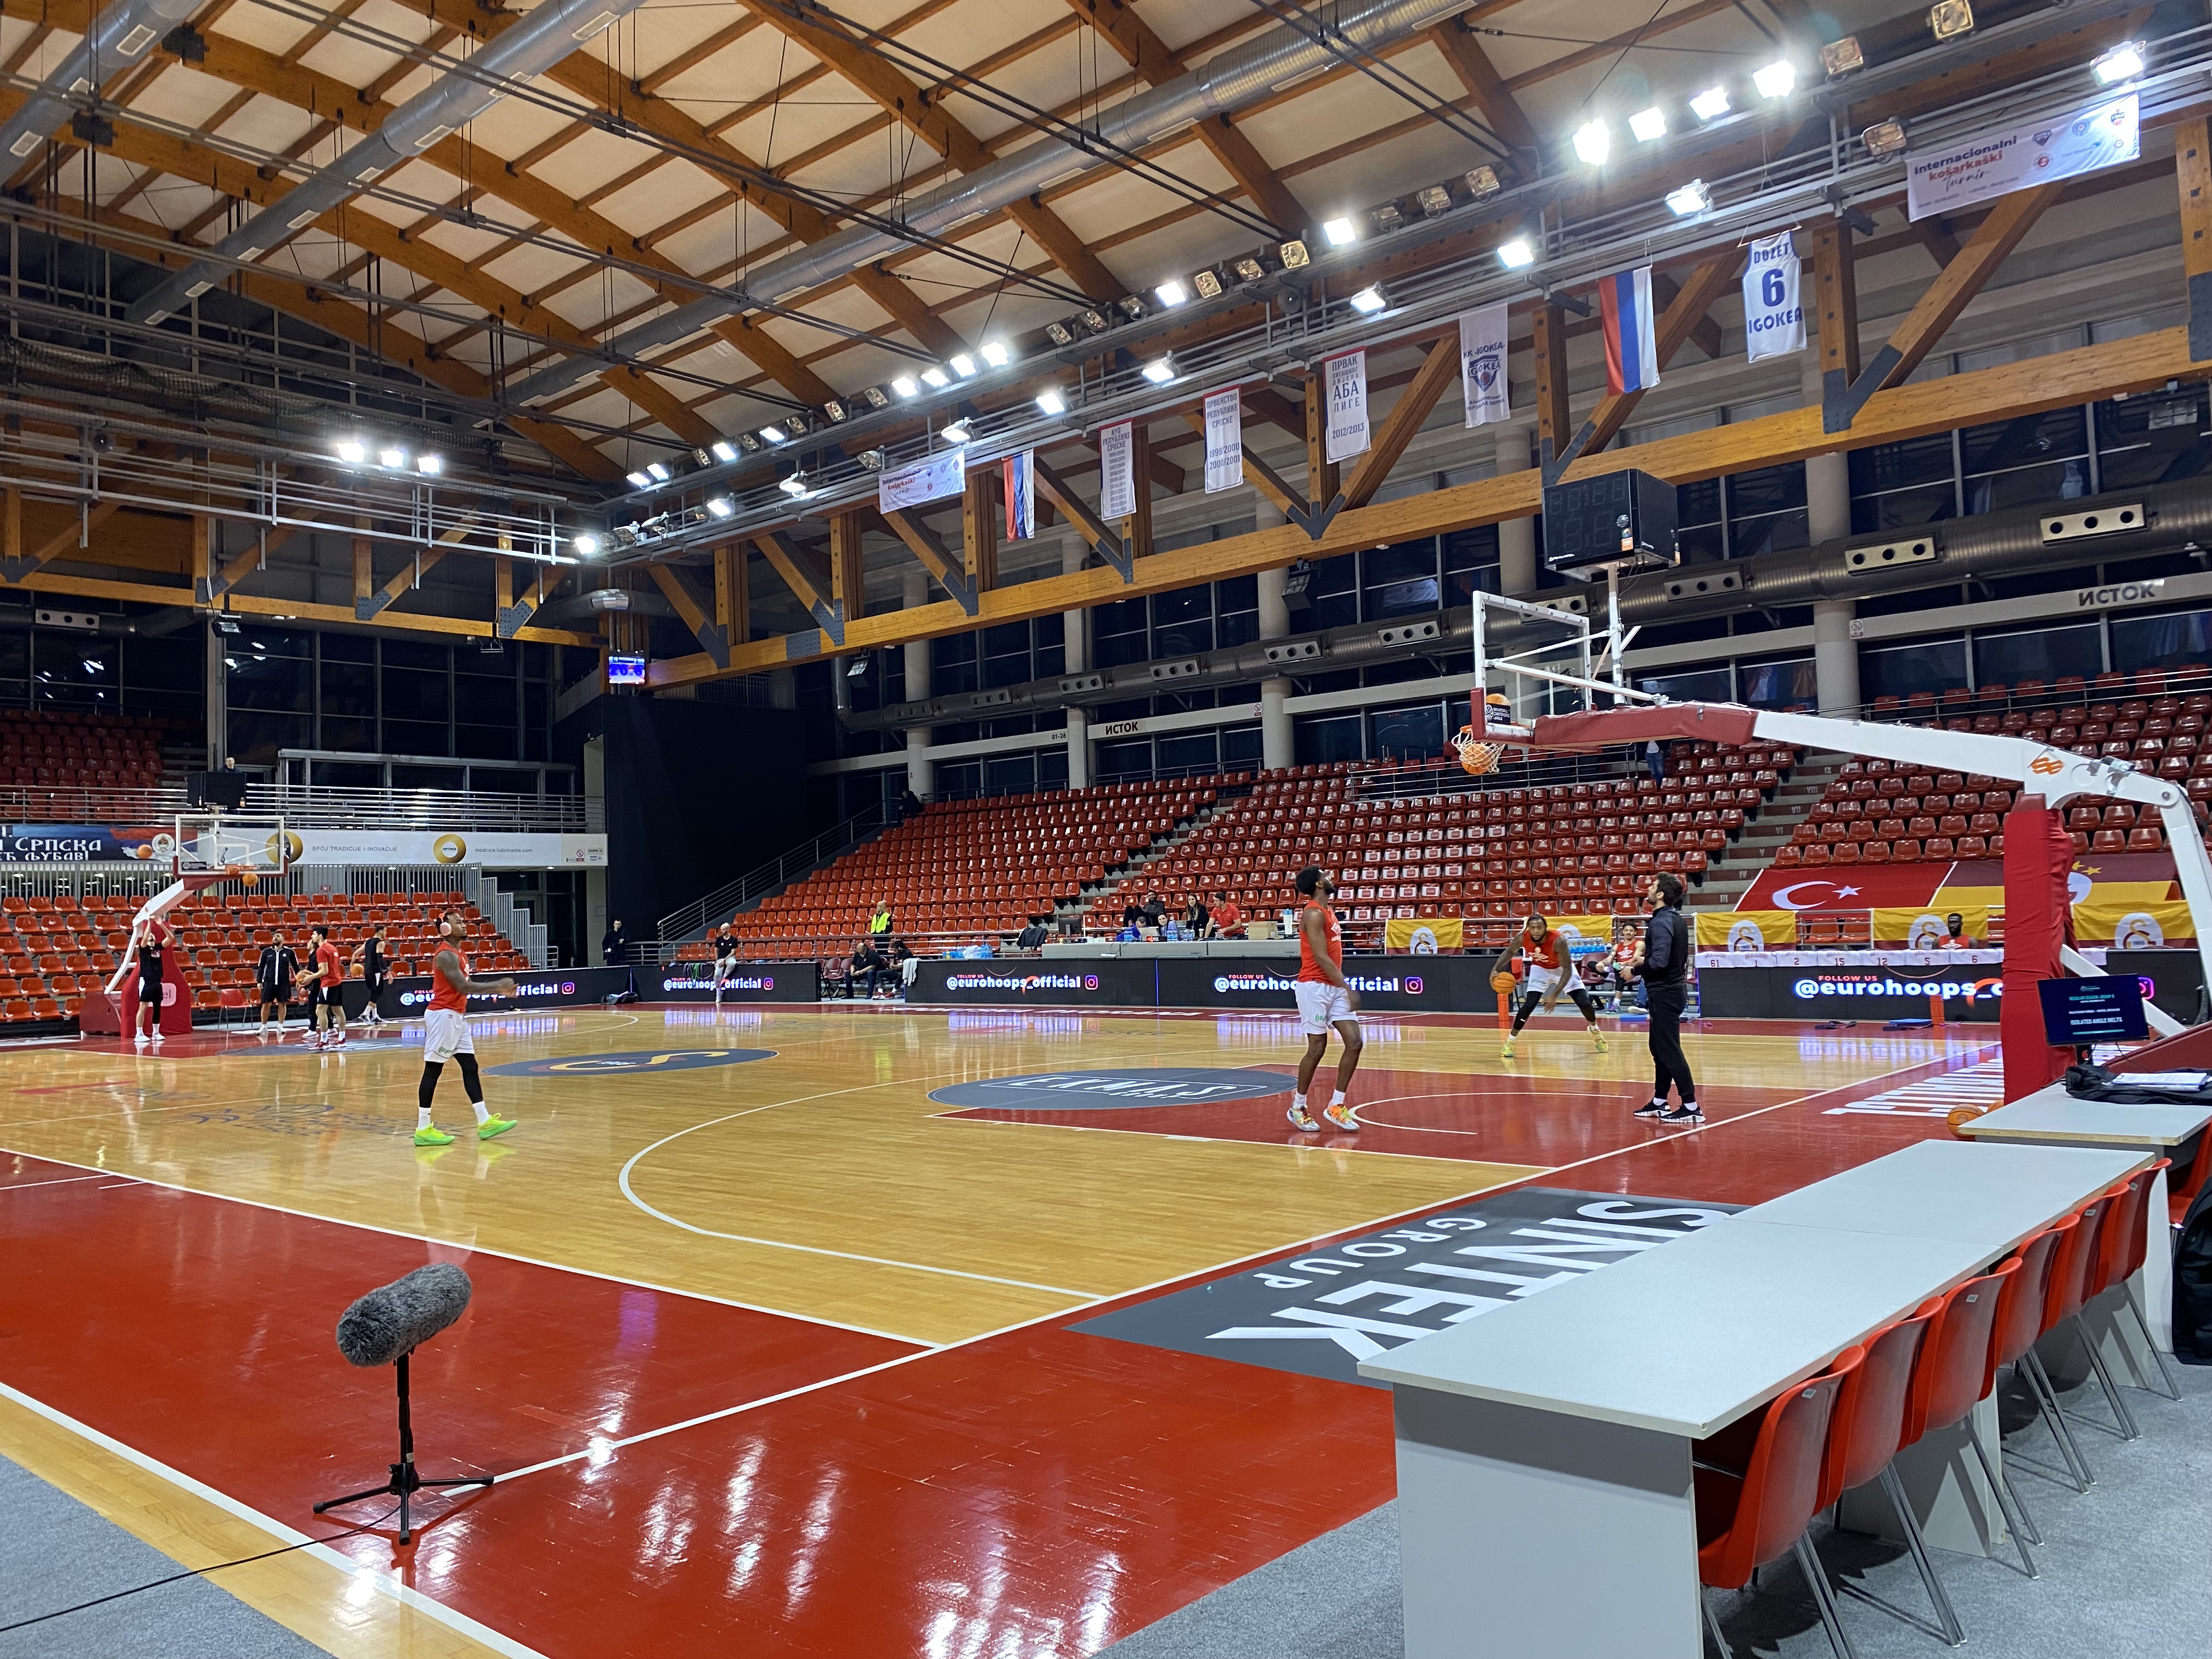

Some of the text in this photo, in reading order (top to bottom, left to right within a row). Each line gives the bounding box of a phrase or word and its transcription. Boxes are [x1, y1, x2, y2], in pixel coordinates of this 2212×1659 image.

[1915, 136, 2017, 174] Internacionalni
[1929, 150, 2002, 181] košarkaški
[1754, 242, 1789, 264] DOZET
[1762, 268, 1785, 307] 6
[1748, 306, 1803, 334] IGOKEA
[1463, 350, 1472, 358] KK
[1332, 356, 1358, 371] ПРВАК
[1468, 361, 1500, 376] IGOKEA
[1333, 380, 1359, 400] АБА
[1207, 393, 1237, 409] ПРВЕНСТВО
[1334, 397, 1360, 413] ЛИГЕ
[1207, 403, 1238, 419] РЕПУБЛИКЕ
[1111, 427, 1121, 436] КУП
[1332, 422, 1364, 439] 2012/2013
[1210, 442, 1239, 458] 1999/2000
[1210, 454, 1240, 470] 2000/2001
[2079, 583, 2155, 606] ИСТОК
[1105, 721, 1138, 735] ИСТОК
[1835, 957, 1844, 966] 15
[1877, 957, 1888, 966] 12
[947, 975, 1081, 990] @eurohoops_official
[1252, 1216, 1487, 1289] GROUP
[1204, 1200, 1731, 1361] SINTEK
